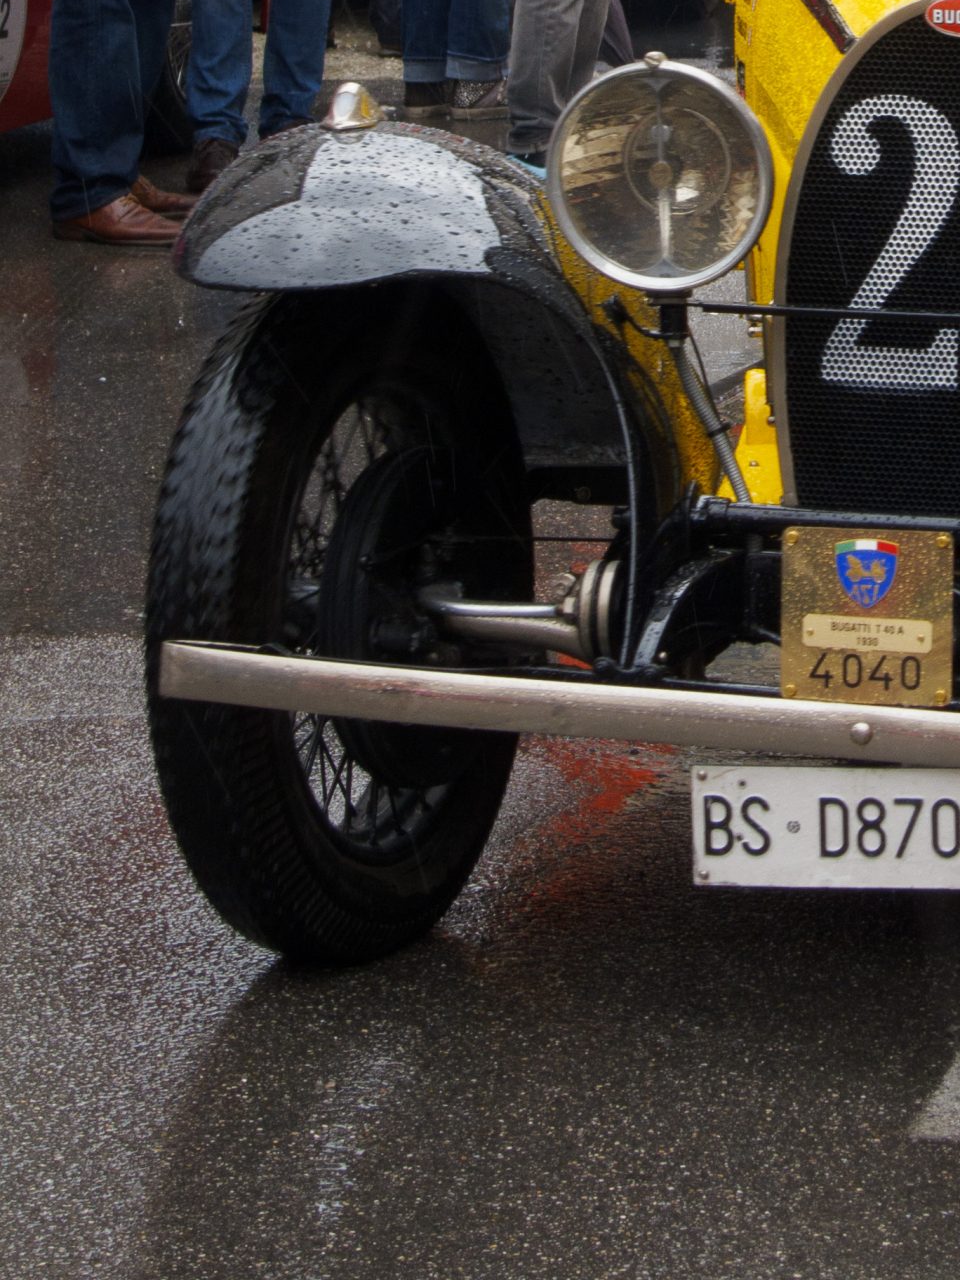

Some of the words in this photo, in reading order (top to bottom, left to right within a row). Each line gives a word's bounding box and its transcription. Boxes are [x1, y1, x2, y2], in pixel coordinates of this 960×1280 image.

[830, 621, 871, 635] BUGATTI
[898, 625, 905, 636] A
[809, 652, 921, 691] 4040
[703, 794, 771, 857] BS
